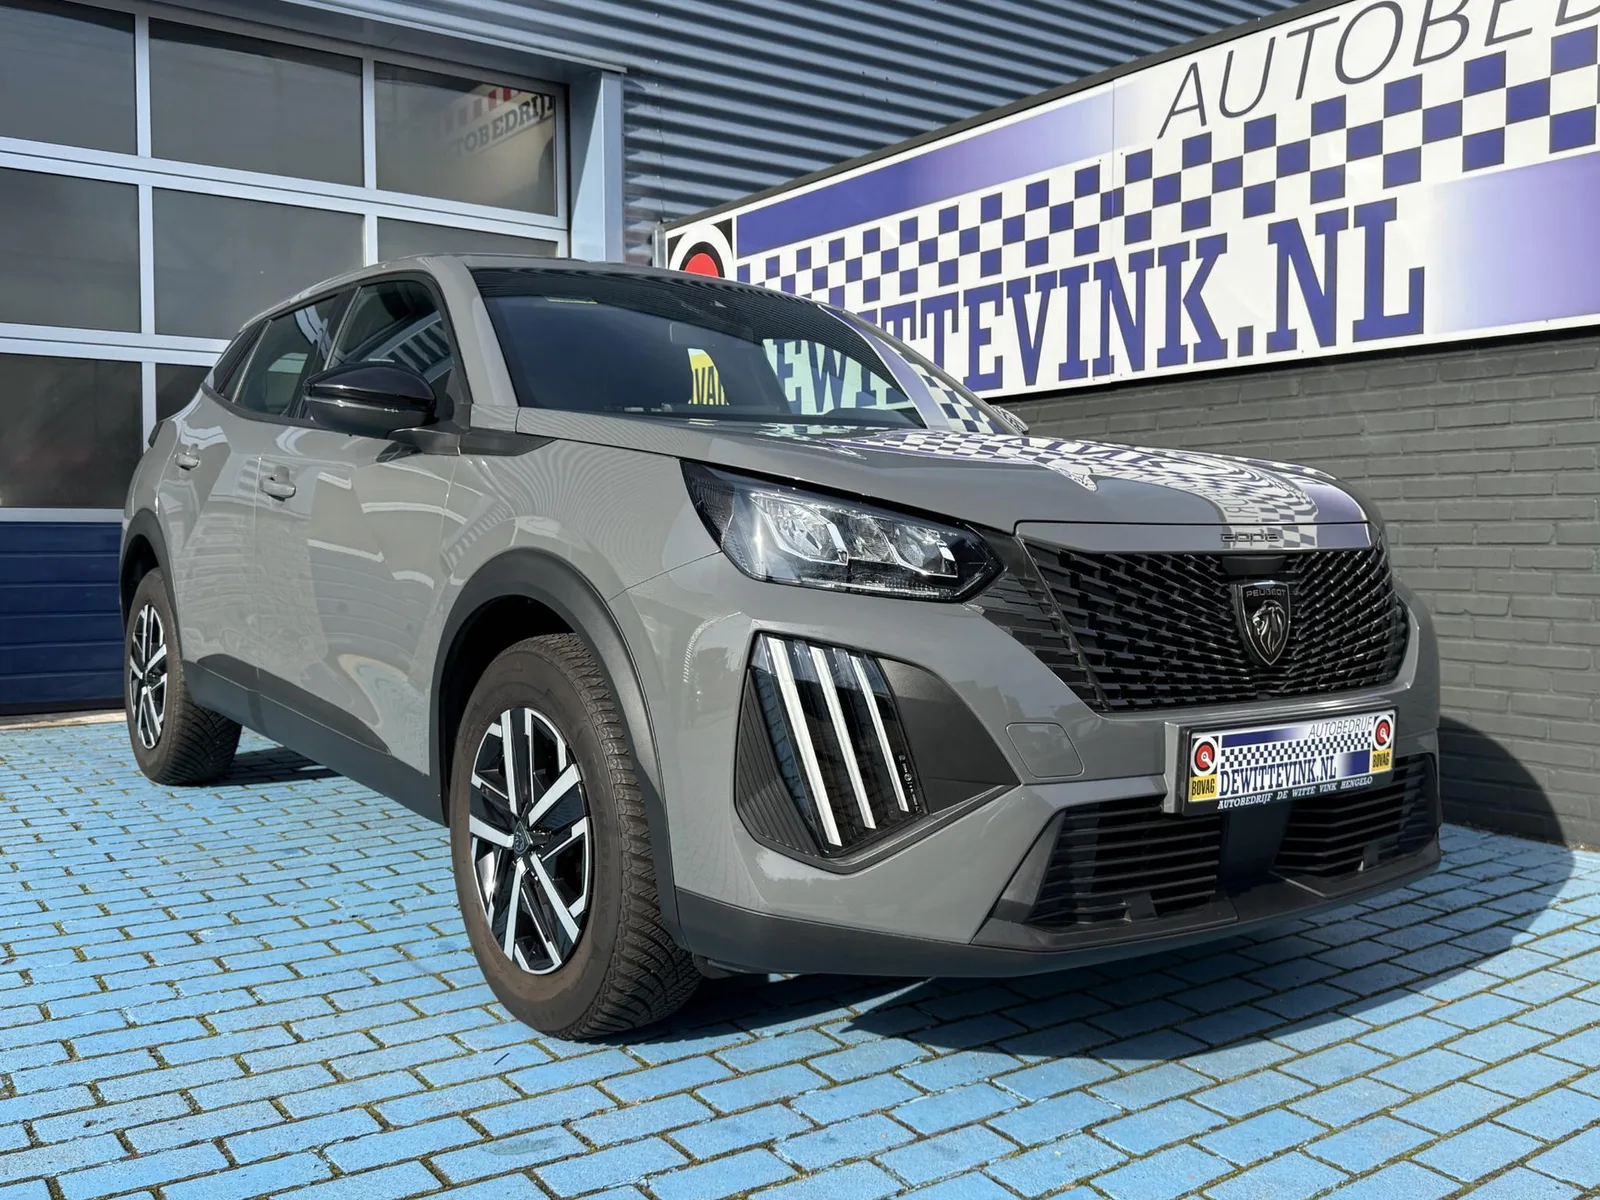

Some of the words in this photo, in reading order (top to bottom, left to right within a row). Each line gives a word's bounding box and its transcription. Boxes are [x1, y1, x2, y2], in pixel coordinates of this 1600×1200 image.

[1157, 0, 1600, 139] AUTOBE
[1246, 589, 1286, 598] PEUGEOT
[1308, 716, 1373, 738] AUTOBEDRIJF
[1372, 752, 1390, 768] BOVAG
[1191, 778, 1215, 796] BOVAG
[1219, 755, 1336, 797] DEWITTEVINK.NL
[1217, 792, 1273, 810] AUTOBEDRIJF
[1276, 790, 1289, 800] DE
[1291, 786, 1316, 798] WITTE
[1319, 782, 1337, 794] VINK
[1340, 776, 1373, 790] HENGELO
